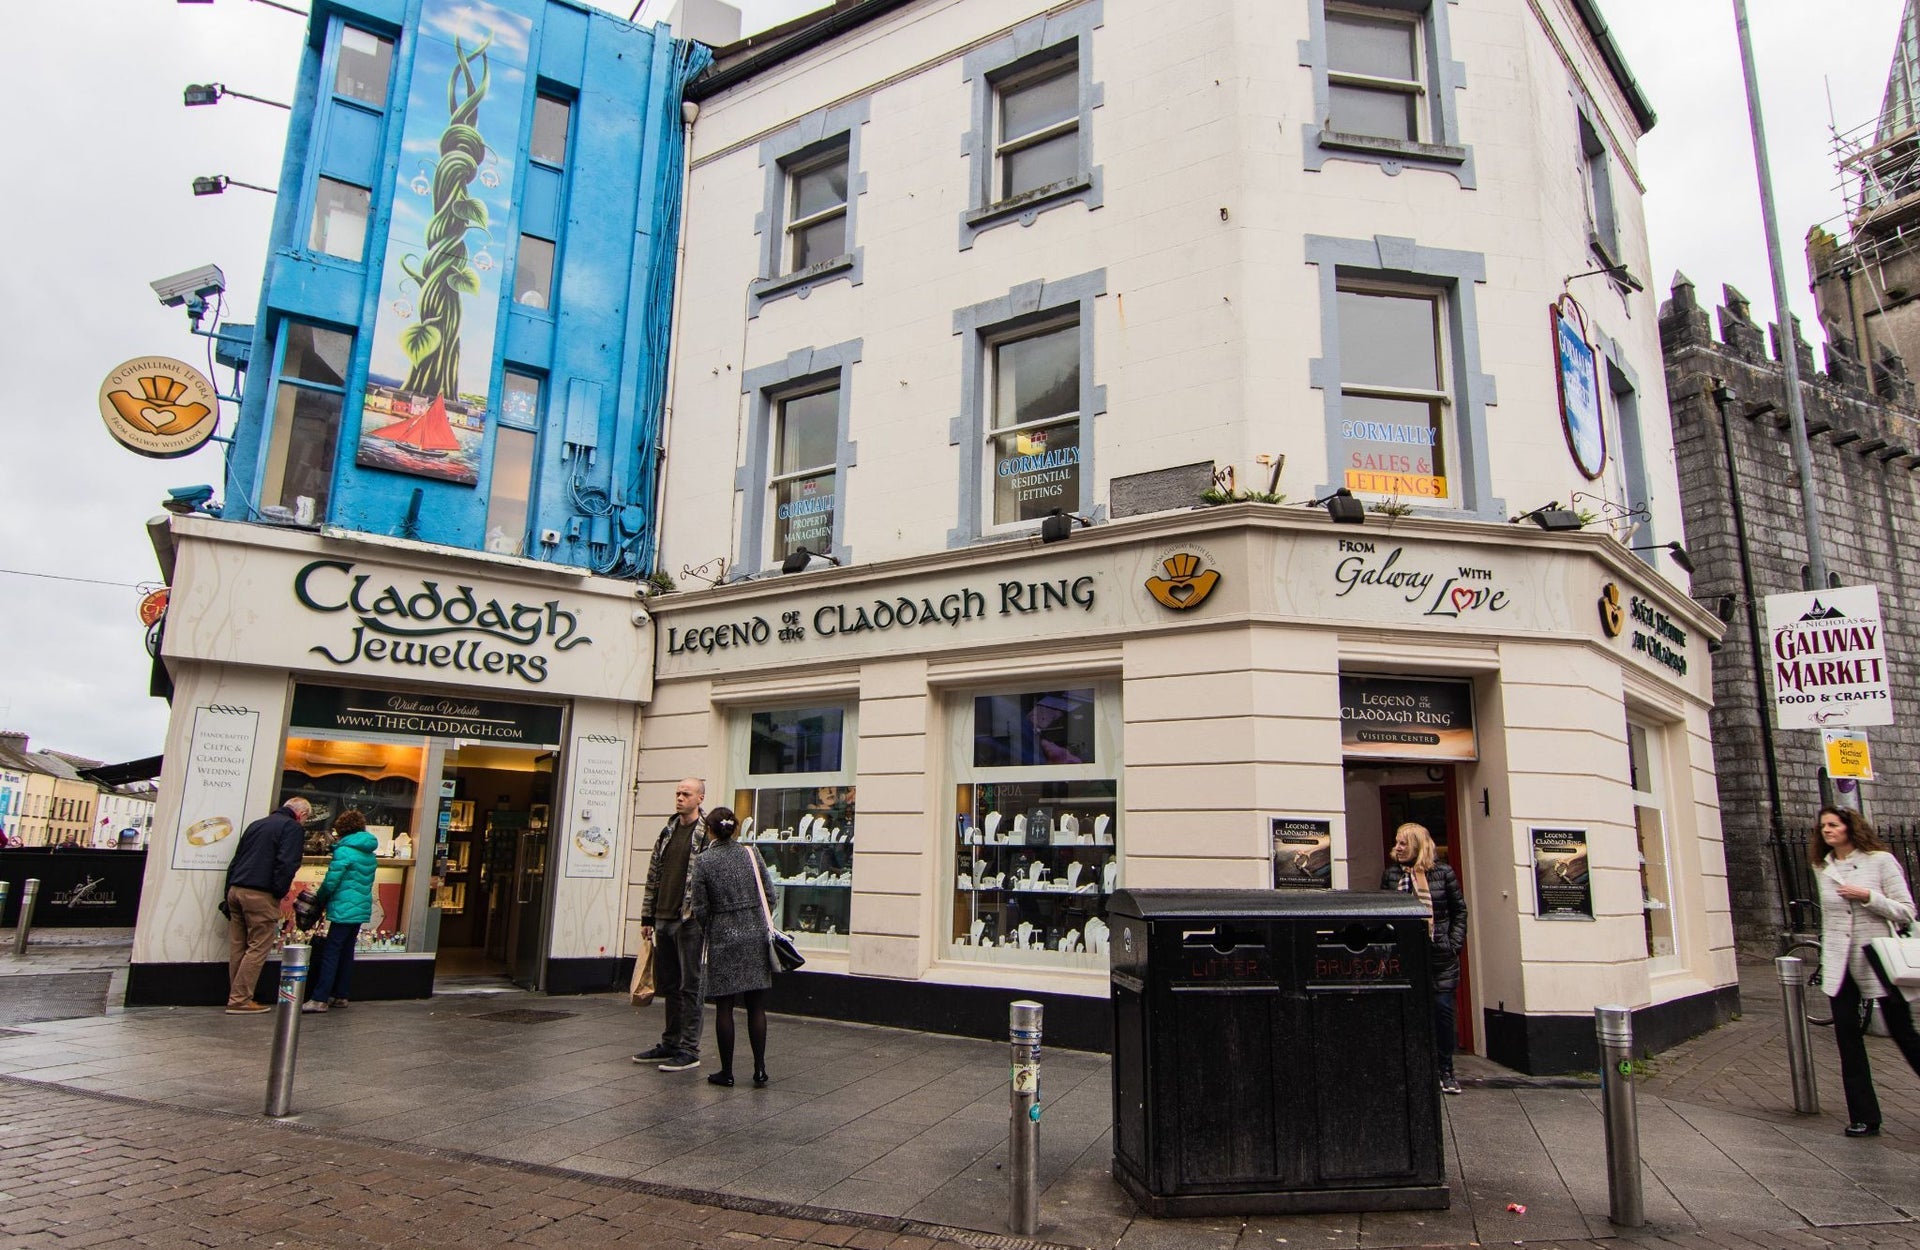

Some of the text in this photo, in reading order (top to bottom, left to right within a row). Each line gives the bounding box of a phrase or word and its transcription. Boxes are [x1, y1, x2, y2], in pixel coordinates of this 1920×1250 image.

[184, 370, 194, 380] LE
[111, 416, 203, 448] FROM GALWAY WITH LOVE
[1342, 420, 1437, 446] GORMALLY
[998, 446, 1080, 477] GORMALLY
[1352, 452, 1430, 473] SALES &
[1011, 468, 1071, 489] RESIDENTIAL
[1345, 472, 1441, 496] LETTINGS
[1018, 484, 1063, 501] LETTINGS
[793, 514, 829, 530] PROPERTY
[1338, 539, 1375, 553] FROM
[1335, 547, 1434, 602] Galway
[1458, 567, 1492, 580] WITH
[295, 560, 593, 651] Claddagh
[813, 589, 985, 637] CLADDAGH
[999, 575, 1095, 616] RING
[1806, 617, 1858, 628] NICHOLAS
[666, 610, 801, 655] LEGEND OF
[1775, 625, 1877, 661] GALWAY
[308, 627, 548, 683] Jewellers
[1776, 657, 1882, 693] MARKET
[388, 696, 480, 717] Visit our Website
[1362, 693, 1415, 708] LEGEND
[1779, 690, 1886, 704] FOOD & CRAFTS
[1341, 707, 1450, 726] CLADDAGH RING
[203, 743, 233, 751] CELTIC
[1362, 732, 1434, 743] VISITOR CENTRE
[196, 755, 245, 764] CLADDAGH
[197, 767, 240, 776] WEDDING
[203, 779, 232, 788] BANDS
[1285, 822, 1310, 830] LEGEND
[1191, 958, 1400, 977] LITTER BRUSCAR
